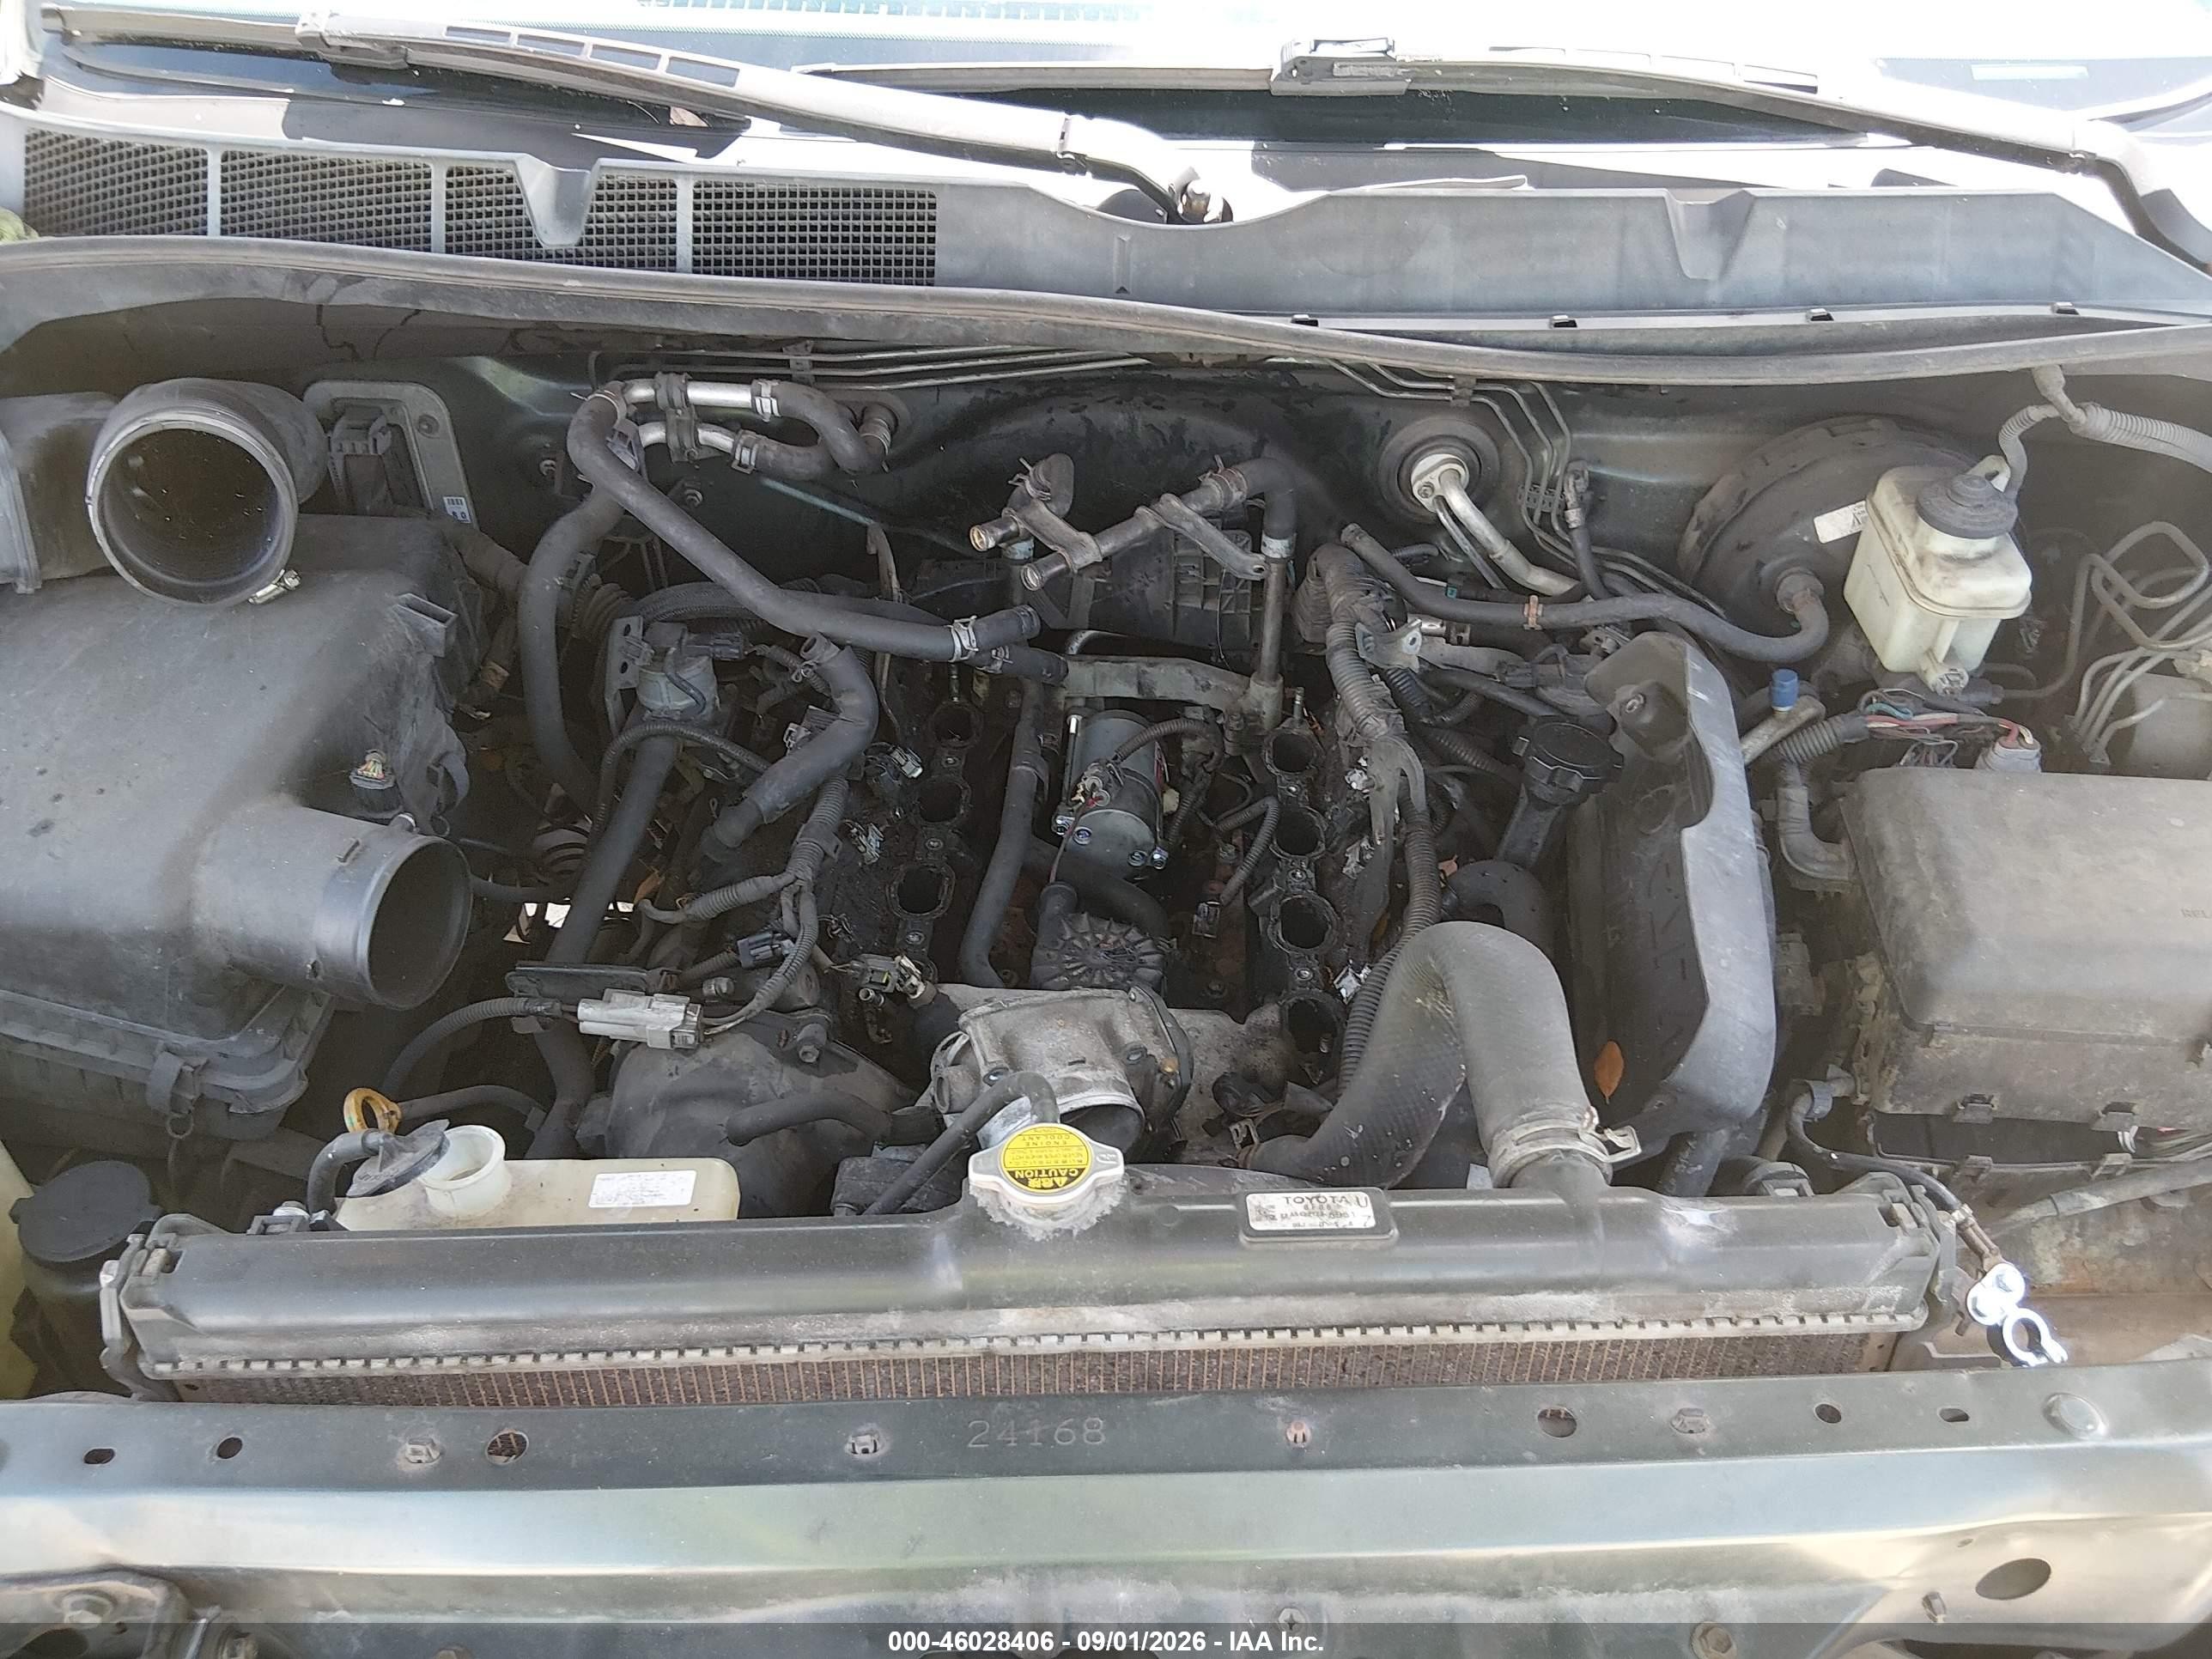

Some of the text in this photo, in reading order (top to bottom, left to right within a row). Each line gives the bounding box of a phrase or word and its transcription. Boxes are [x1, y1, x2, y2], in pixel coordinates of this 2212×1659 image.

[1015, 1168, 1079, 1178] CAUTION
[1283, 1195, 1349, 1204] TOYOTA
[967, 1418, 1106, 1448] 24168
